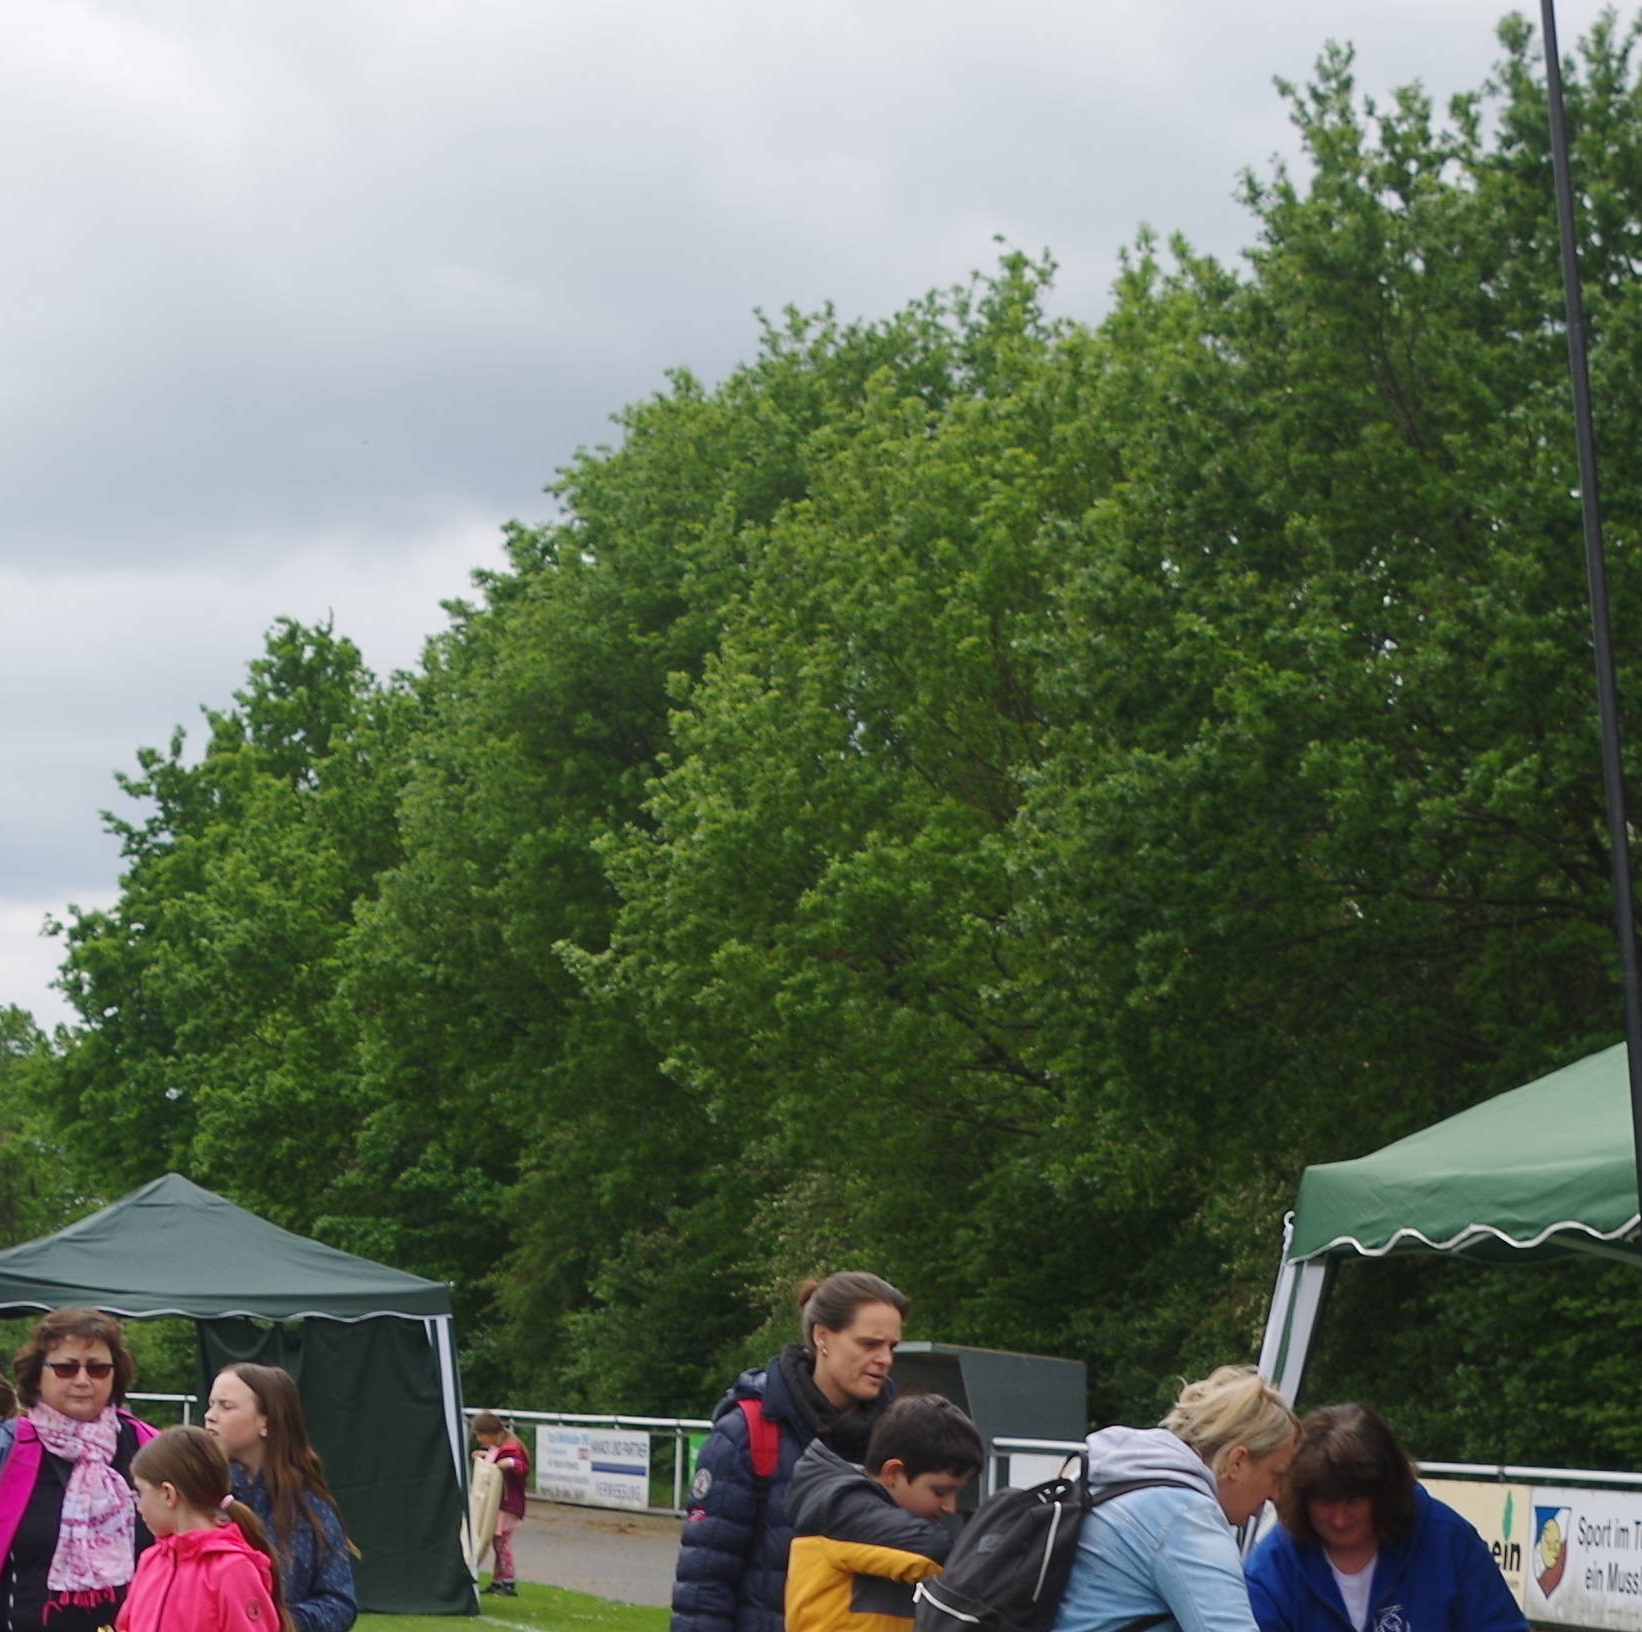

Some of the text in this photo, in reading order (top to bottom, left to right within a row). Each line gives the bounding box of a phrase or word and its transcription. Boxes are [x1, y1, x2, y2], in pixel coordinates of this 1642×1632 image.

[1578, 1515, 1612, 1553] Sport
[1614, 1517, 1630, 1549] im
[1485, 1539, 1521, 1572] ein
[1585, 1560, 1604, 1592] ein
